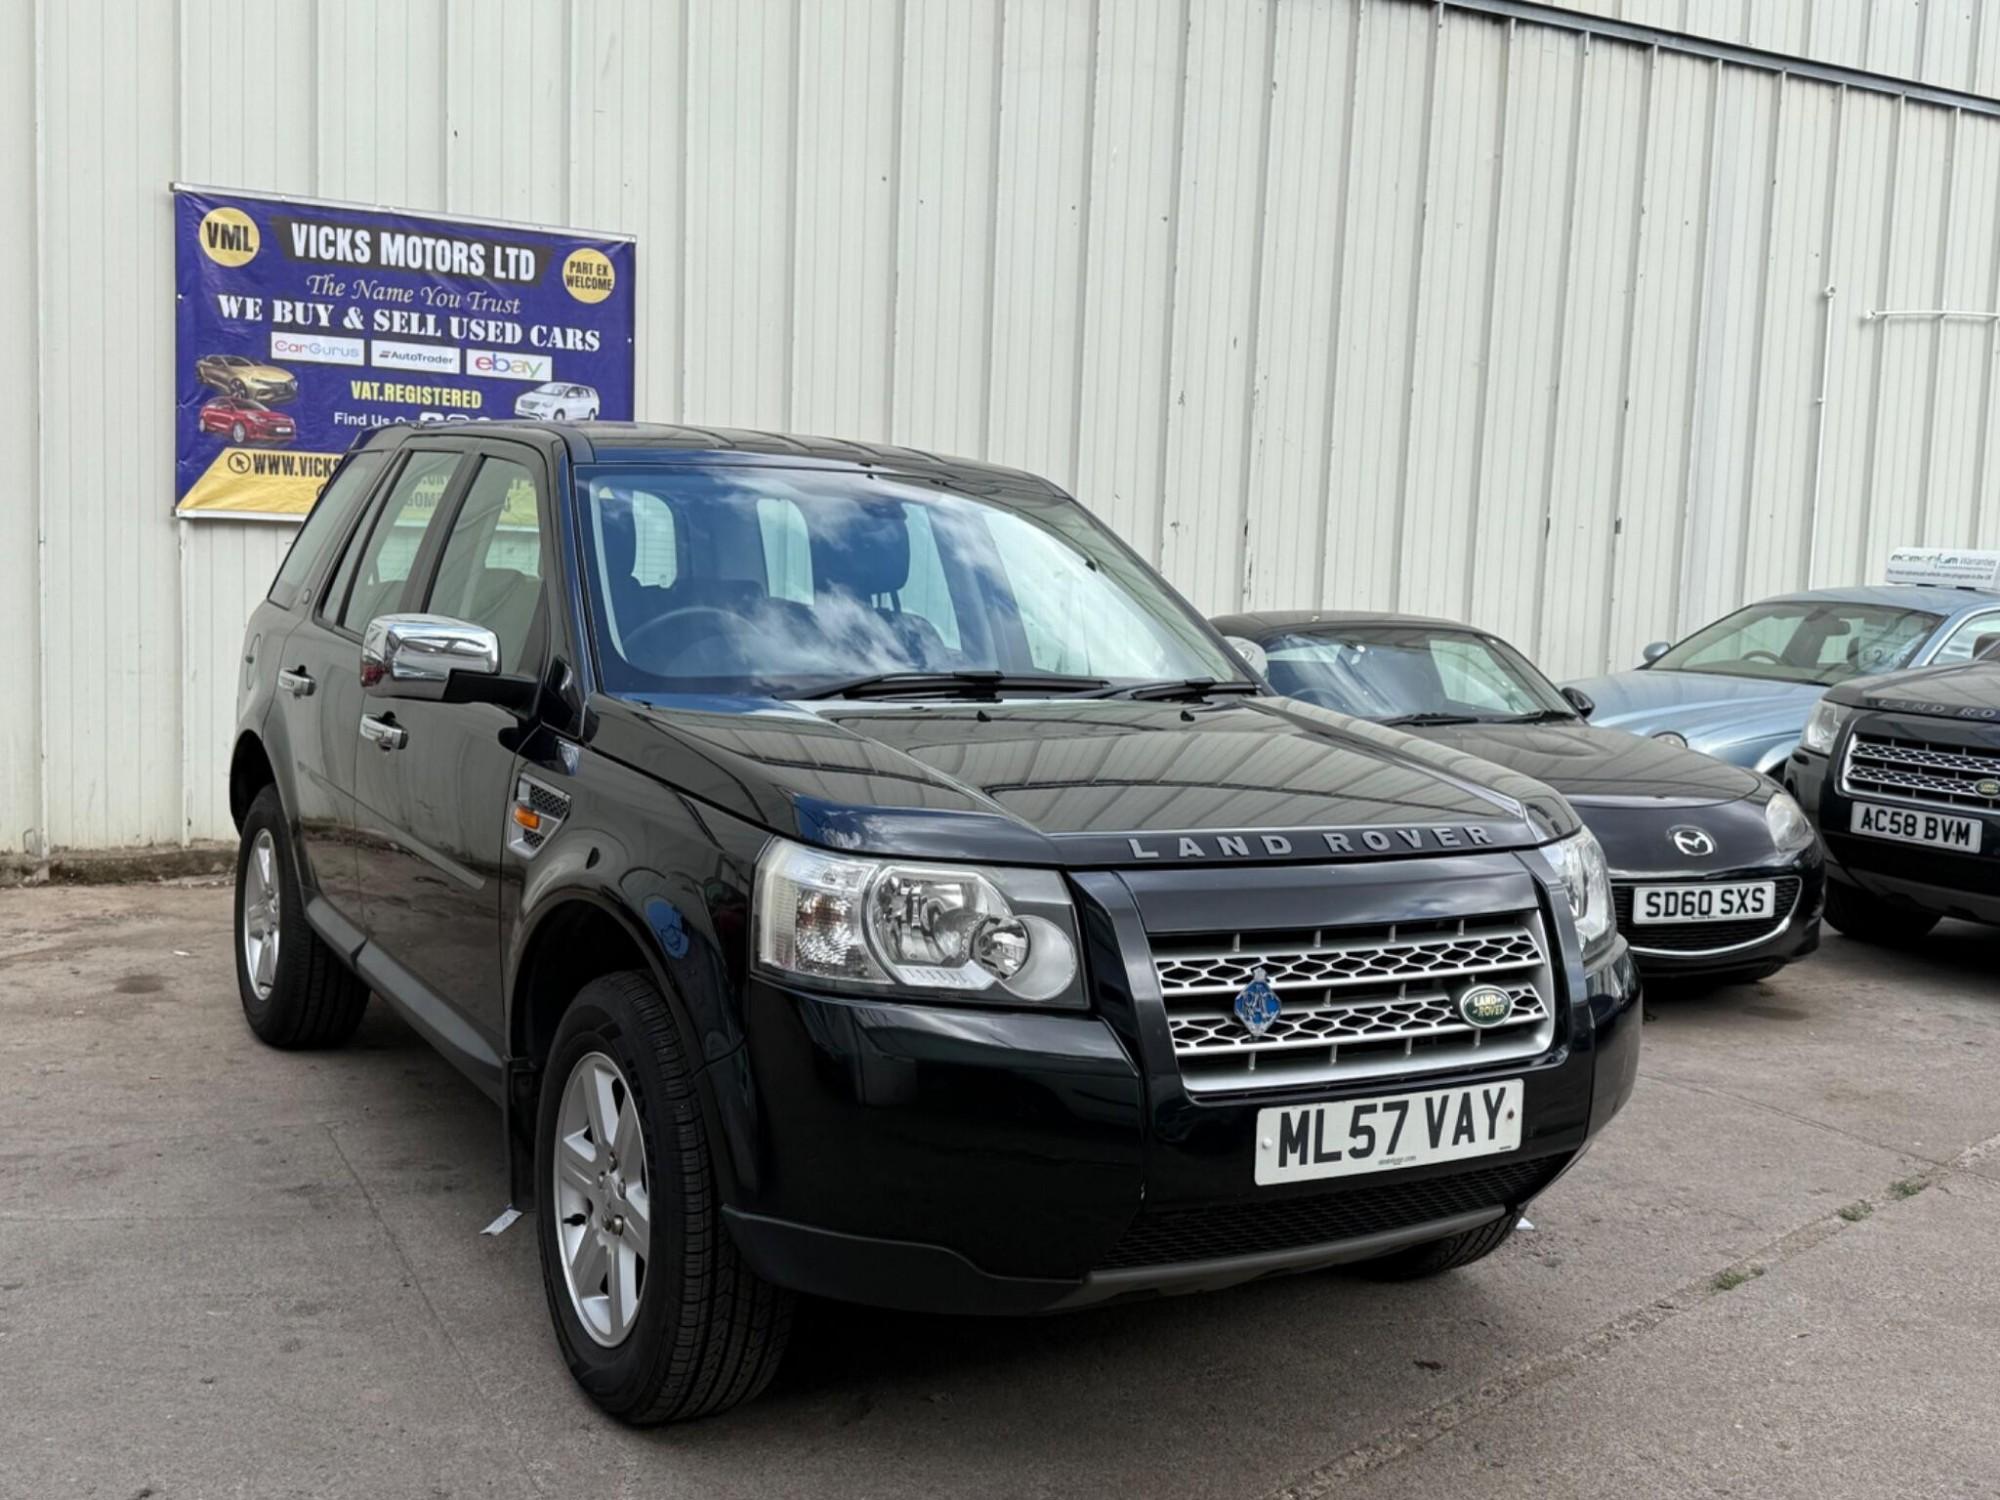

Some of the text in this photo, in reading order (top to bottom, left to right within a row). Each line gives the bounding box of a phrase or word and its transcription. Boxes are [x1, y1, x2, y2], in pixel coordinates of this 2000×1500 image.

[206, 221, 254, 253] VML
[291, 222, 536, 281] VICKS MOTORS LTD
[569, 261, 609, 277] PART EX
[306, 273, 521, 314] The Name You Trust
[566, 275, 613, 291] WELCOME
[217, 294, 601, 352] WE BUY & SELL USED CARS
[274, 339, 360, 359] CarGurus
[391, 351, 454, 365] AutoTrader
[475, 352, 543, 378] ebay
[351, 380, 483, 409] VAT.REGISTERED
[334, 412, 367, 426] Find
[371, 414, 390, 427] Us
[1878, 699, 1945, 713] LAND
[1860, 807, 1971, 846] AC58 BVM
[1128, 826, 1493, 859] LAND ROVER
[1645, 887, 1766, 918] SD60 SXS
[1474, 994, 1497, 1007] LAND
[1478, 1004, 1505, 1017] ROVER
[1278, 1086, 1506, 1168] ML57 VAY
